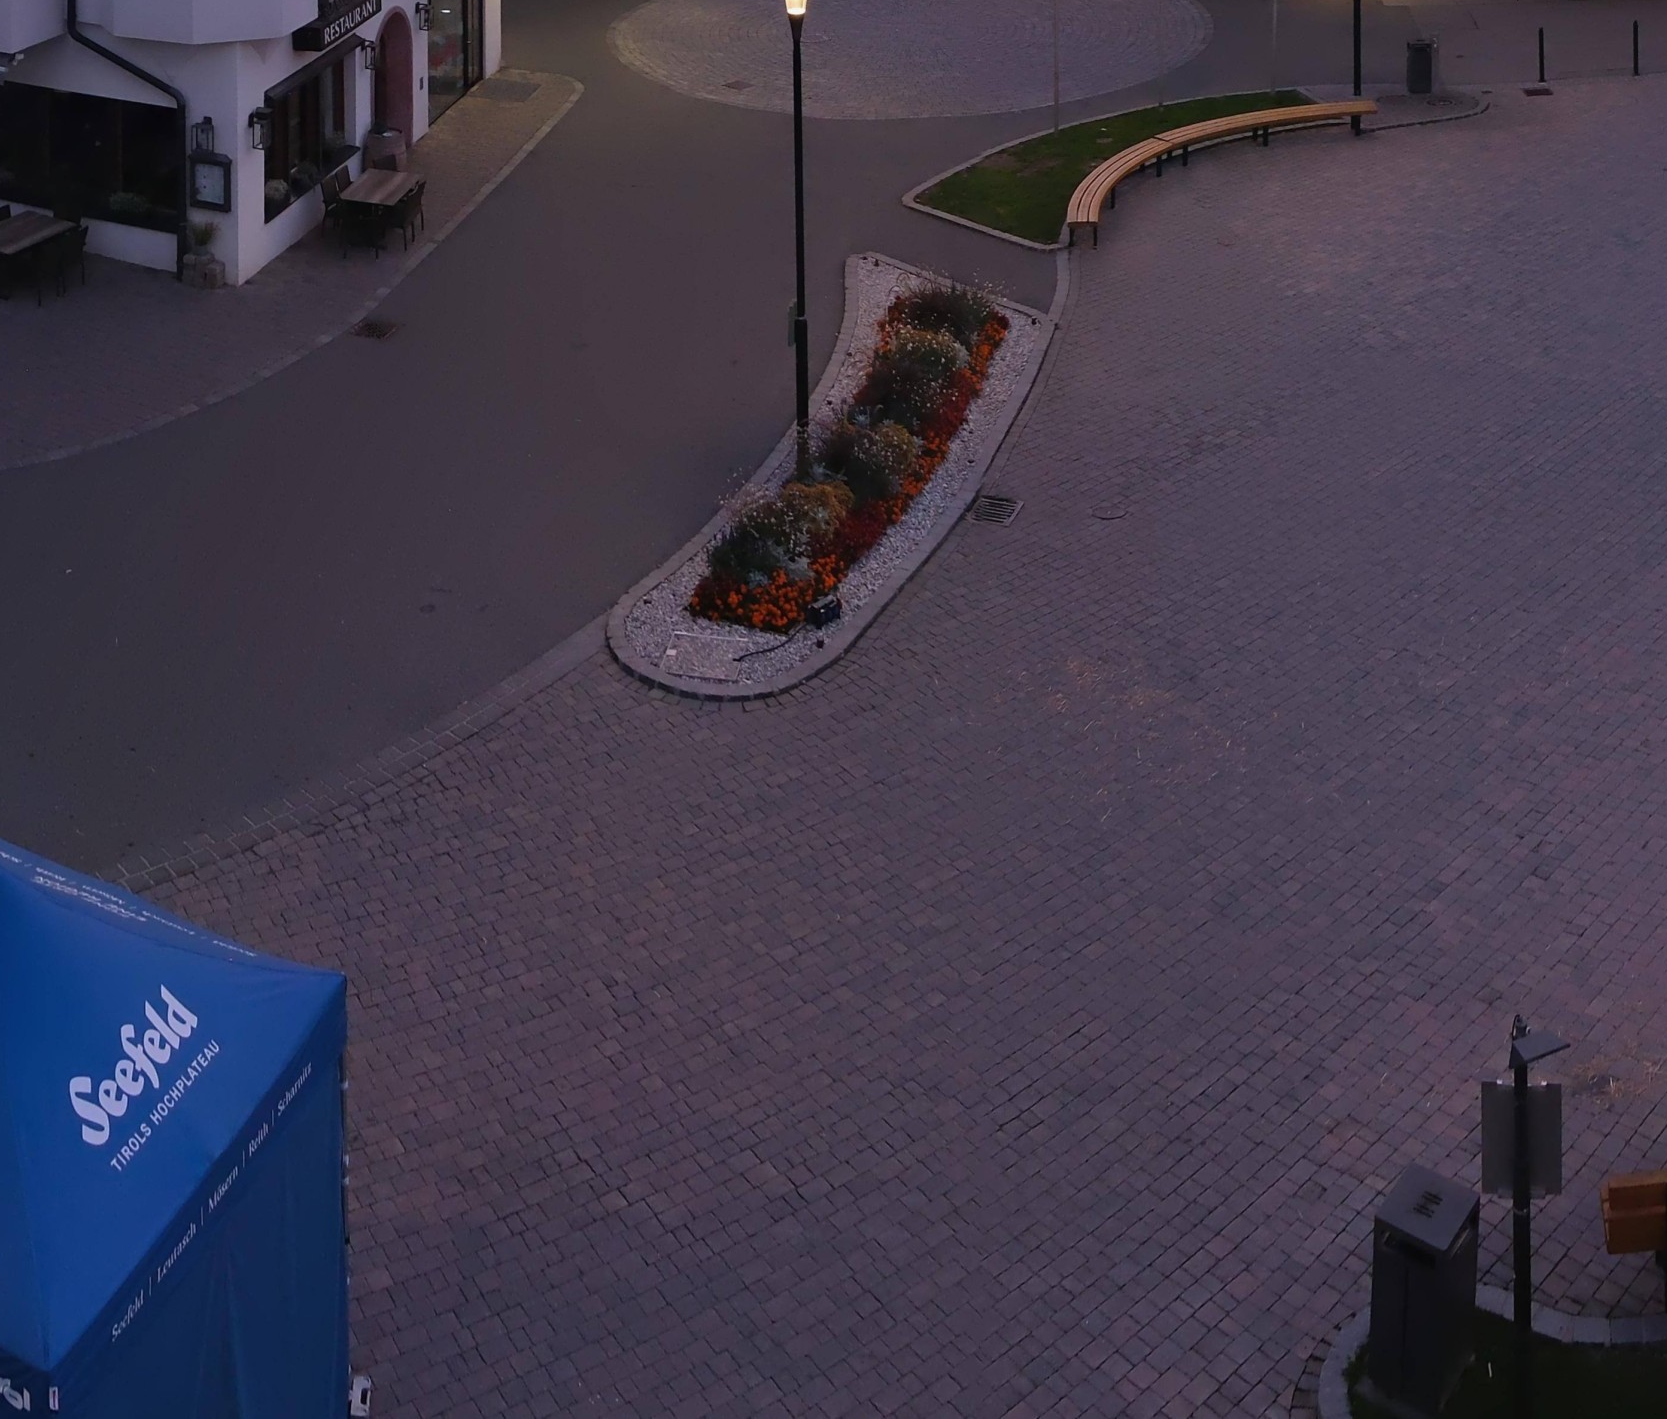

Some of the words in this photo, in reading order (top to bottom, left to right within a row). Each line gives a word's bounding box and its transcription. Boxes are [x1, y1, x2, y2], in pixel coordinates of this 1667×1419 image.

[69, 983, 198, 1146] Seefeld
[110, 1123, 152, 1172] TIROLS
[151, 1039, 220, 1125] HOCHPLATEAU
[111, 1290, 145, 1342] Seefeld
[156, 1222, 197, 1284] Leutasch
[208, 1165, 239, 1214] Mösern
[248, 1123, 270, 1158] Reith
[277, 1062, 313, 1117] Scharnitz
